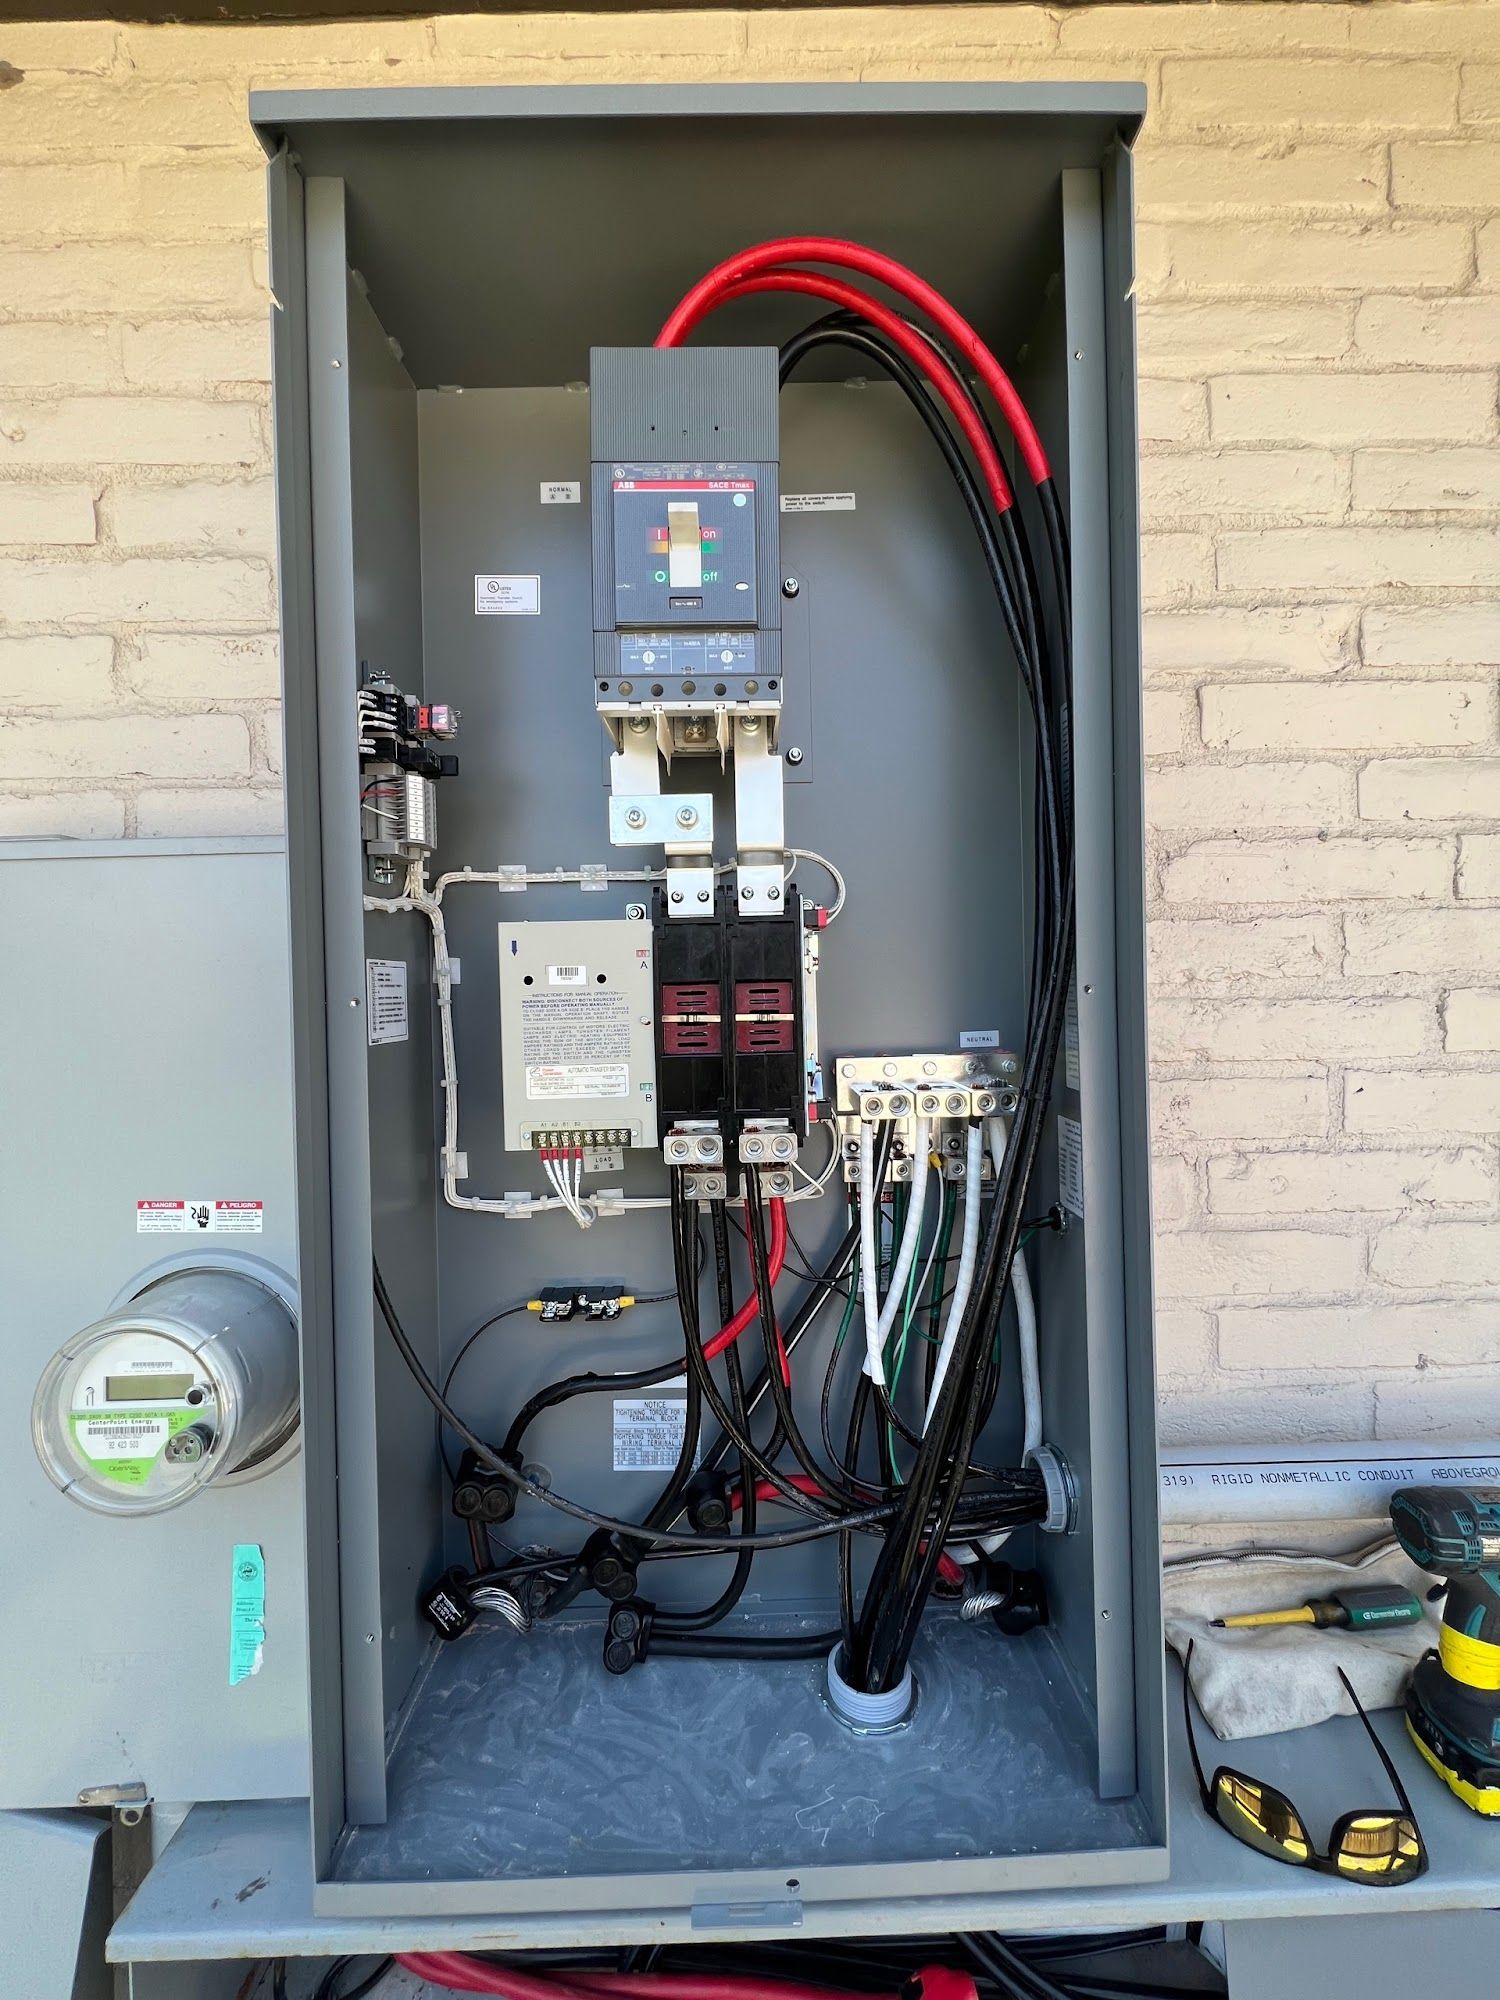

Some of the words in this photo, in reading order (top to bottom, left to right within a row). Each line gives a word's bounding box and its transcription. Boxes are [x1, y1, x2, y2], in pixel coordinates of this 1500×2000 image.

[703, 572, 718, 582] off
[640, 961, 648, 969] A
[646, 1094, 652, 1102] B
[1211, 1474, 1254, 1485] RIGID
[1260, 1470, 1351, 1484] NONMETALLIC
[1358, 1469, 1414, 1481] CONDUIT
